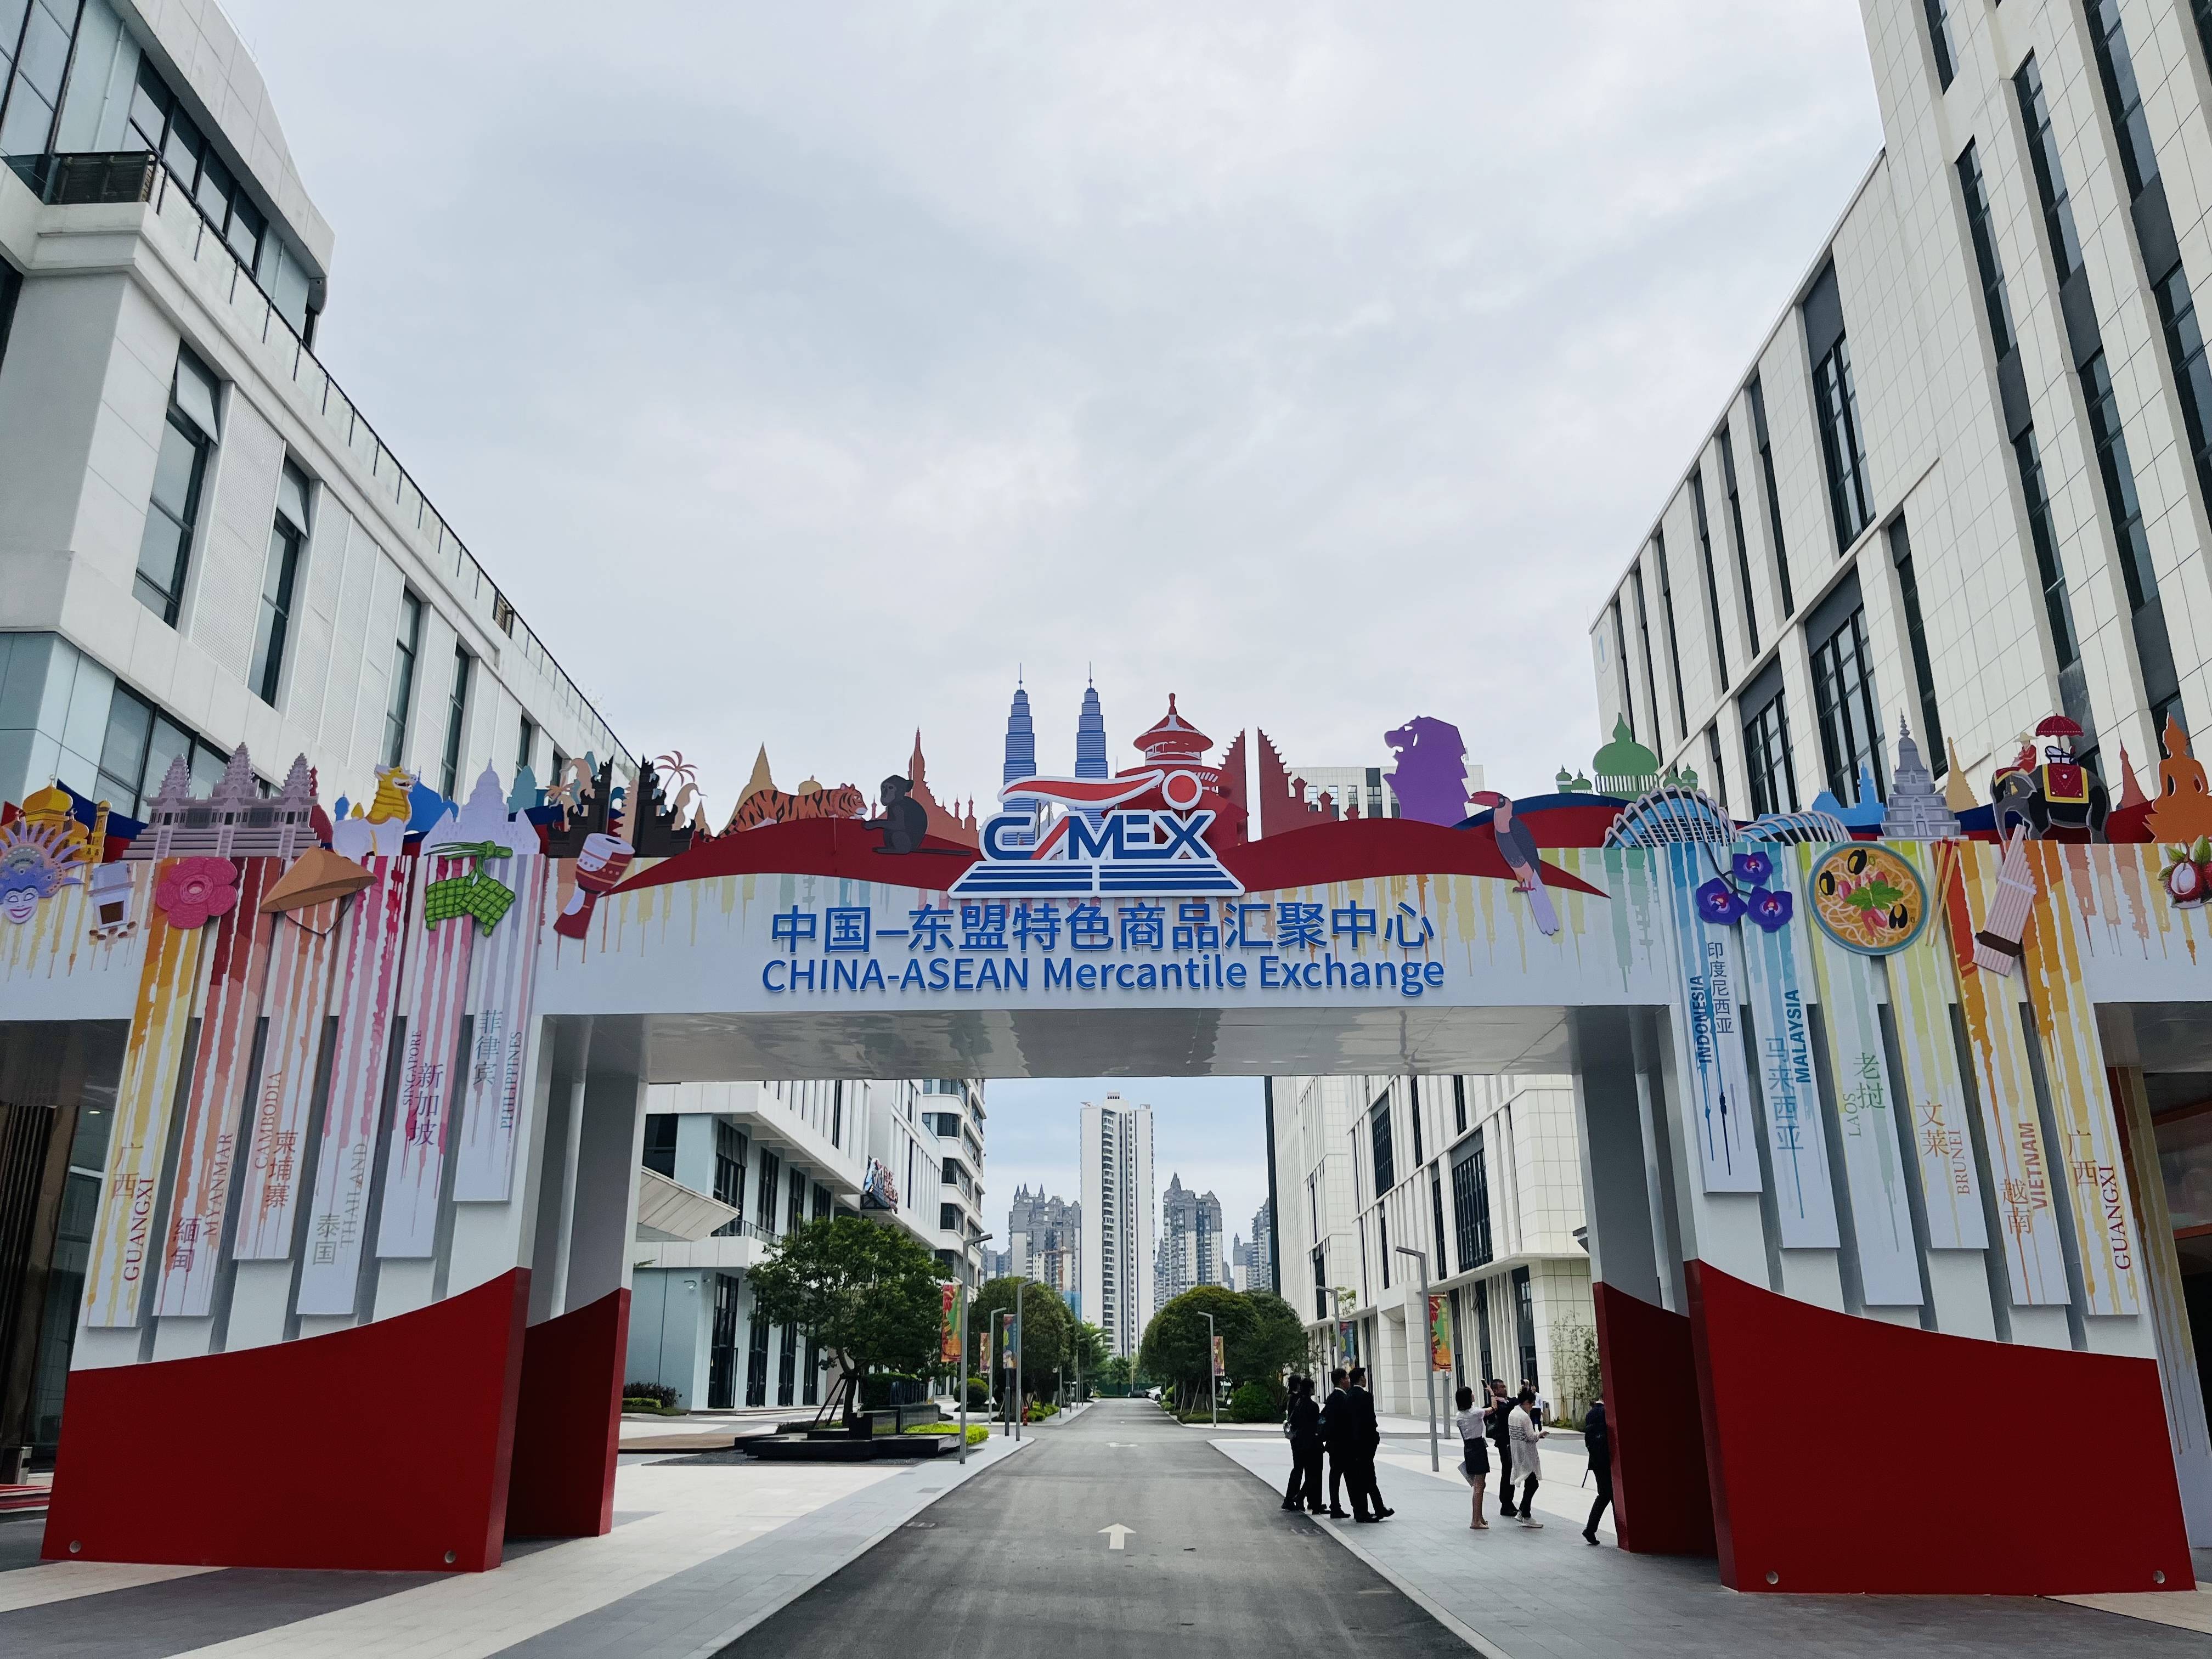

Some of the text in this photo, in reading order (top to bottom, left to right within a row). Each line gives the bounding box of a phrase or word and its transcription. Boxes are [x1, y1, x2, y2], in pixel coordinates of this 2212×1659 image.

[984, 814, 1216, 860] CAMEX
[762, 952, 1445, 997] CHINA-ASEAN Mercantile Exchange
[1708, 941, 1734, 1034] 印度尼西亚
[473, 1010, 503, 1086] 菲律宾
[1689, 975, 1713, 1064] INDONESIA
[1784, 989, 1811, 1084] MALAYSIA
[402, 1030, 422, 1107] SINGAPORE
[409, 1062, 444, 1147] 新加坡
[500, 1030, 523, 1130] PHILIPPINES
[1764, 1036, 1804, 1150] 马来西亚
[1852, 1052, 1886, 1111] 老挝
[254, 1070, 283, 1170] CAMBODIA
[1842, 1092, 1862, 1138] LAOS
[1915, 1099, 1950, 1159] 文莱
[111, 1143, 143, 1199] 广西
[202, 1132, 235, 1237] MYANMAR
[266, 1130, 299, 1208] 柬埔寨
[339, 1143, 368, 1249] THAILAND
[1947, 1130, 1971, 1196] BRUNEI
[2017, 1122, 2049, 1210] VIETNAM
[2067, 1129, 2099, 1187] 广西
[123, 1178, 156, 1282] GUANGXI
[312, 1214, 341, 1265] 泰国
[1999, 1178, 2033, 1235] 越南
[2098, 1165, 2132, 1270] GUANGXI
